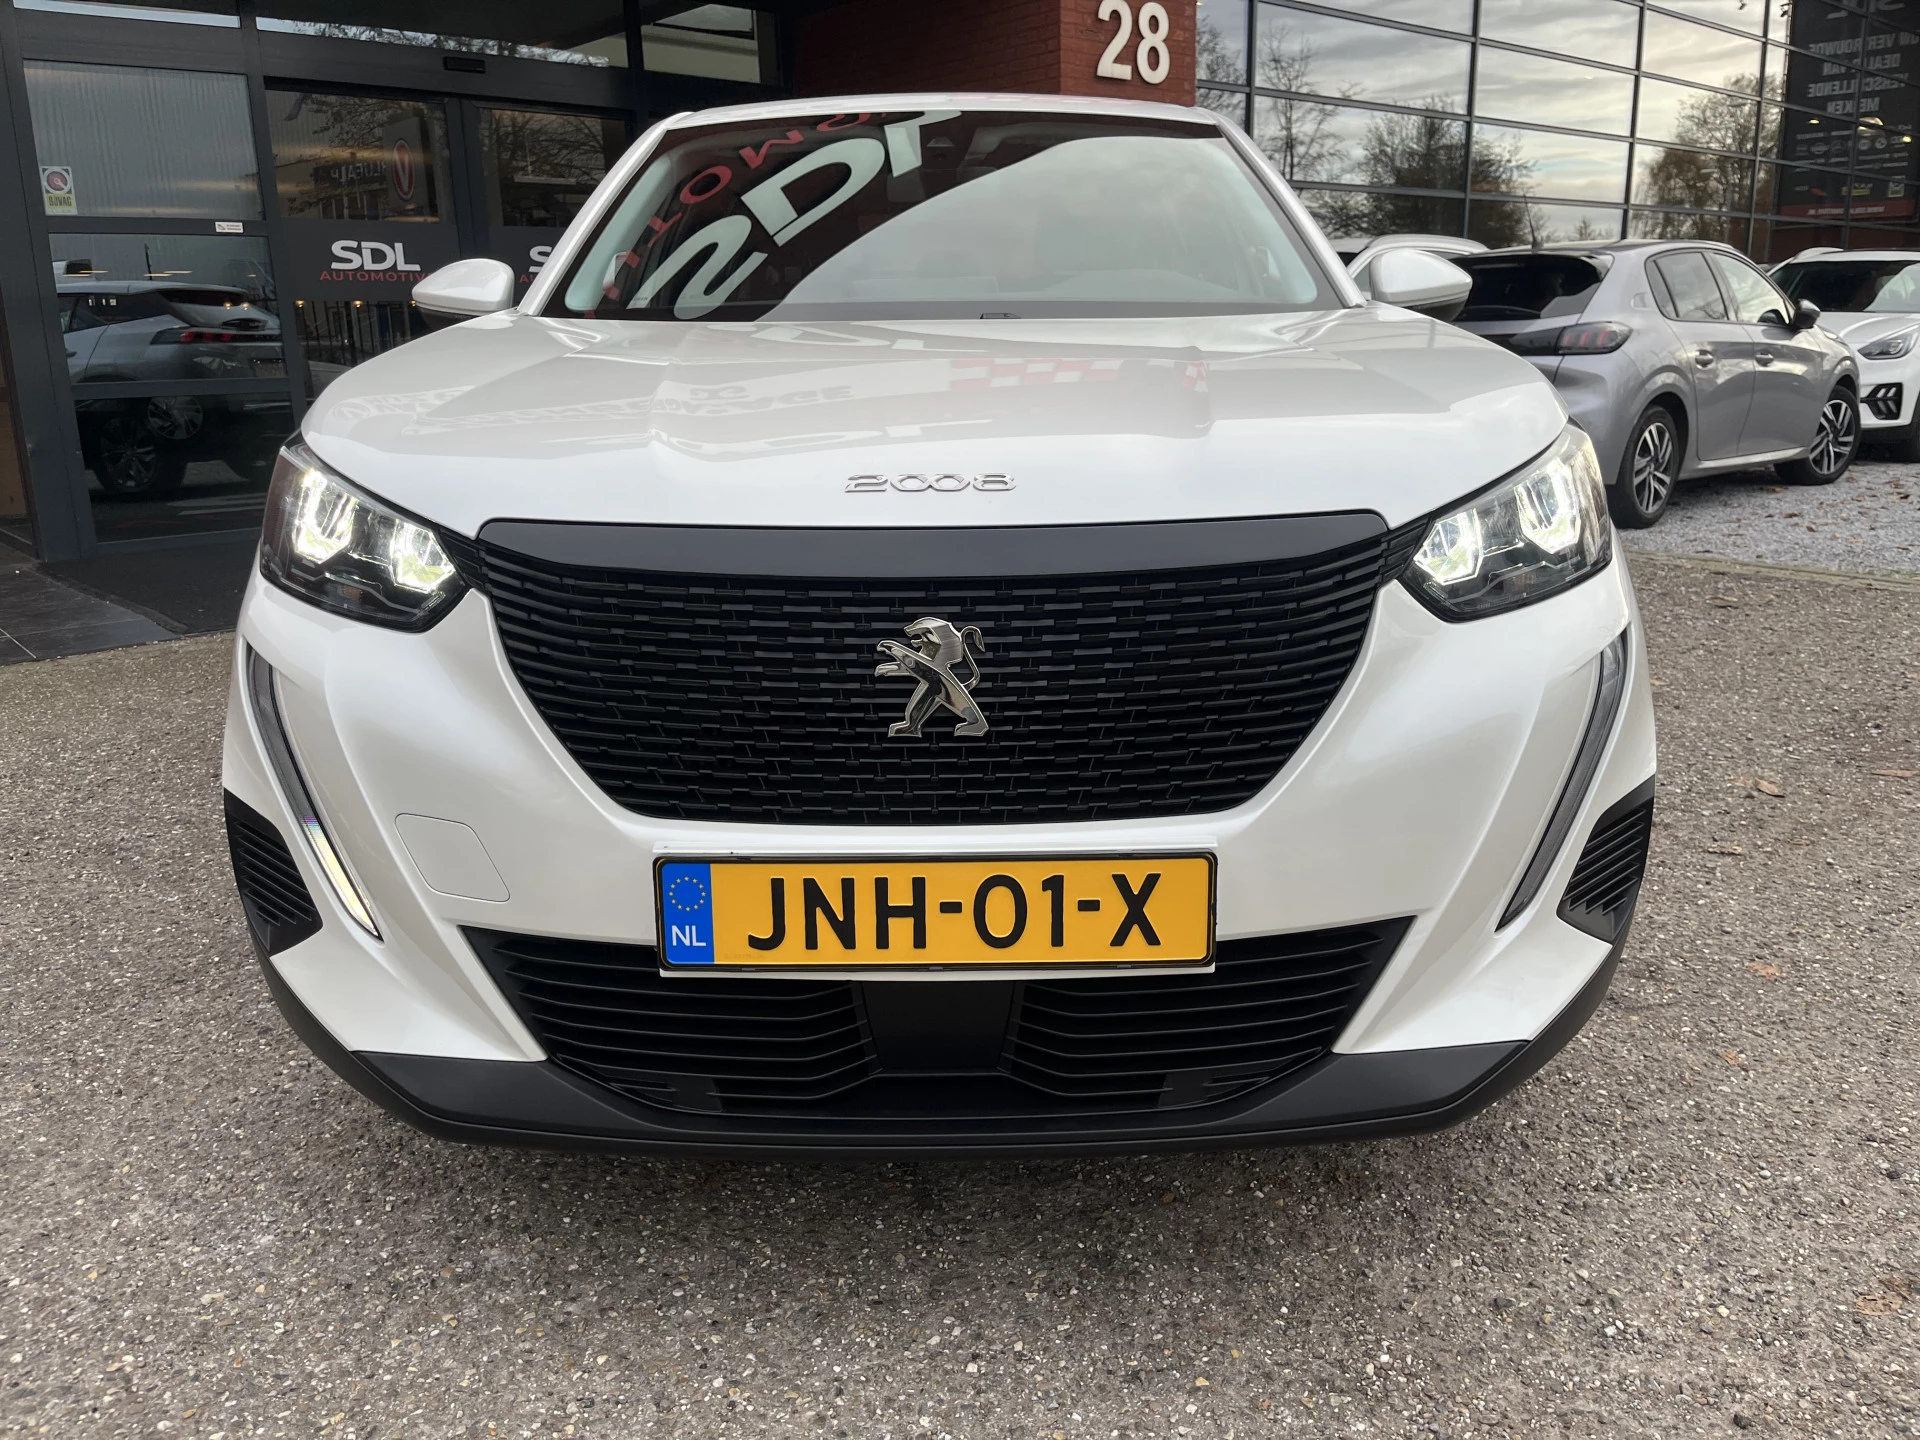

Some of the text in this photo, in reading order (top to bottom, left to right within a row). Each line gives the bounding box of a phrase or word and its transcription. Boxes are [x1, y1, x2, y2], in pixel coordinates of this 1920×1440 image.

[1096, 0, 1170, 85] 28
[48, 195, 72, 207] BOVAG
[331, 239, 421, 271] SDL
[319, 270, 433, 282] AUTOMOTIV
[845, 473, 1016, 493] 2008
[747, 873, 1162, 952] JNH-01-X
[670, 925, 707, 948] NL
